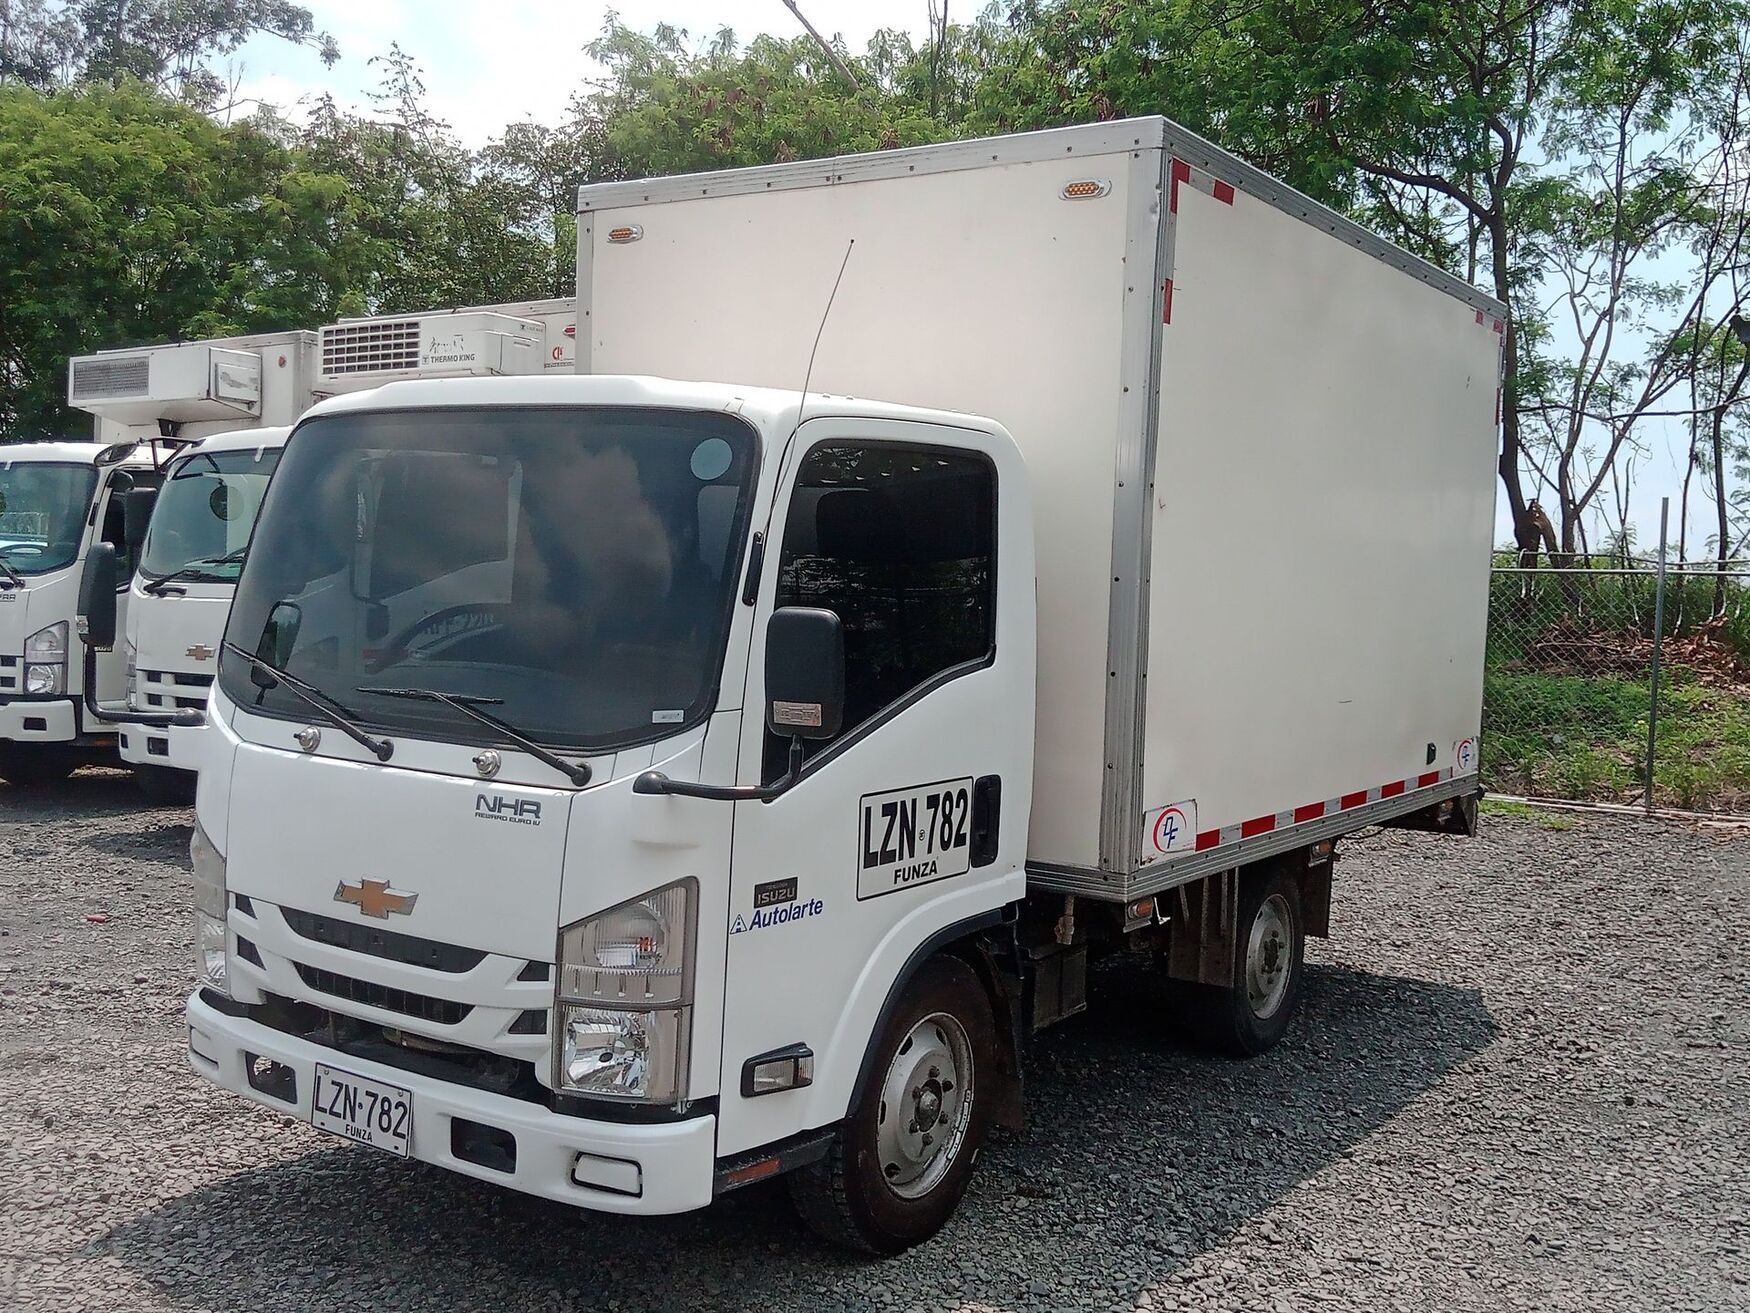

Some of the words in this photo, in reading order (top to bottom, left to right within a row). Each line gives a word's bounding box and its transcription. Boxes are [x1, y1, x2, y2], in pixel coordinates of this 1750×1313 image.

[431, 355, 459, 364] THERMO
[459, 353, 475, 361] KING
[475, 793, 541, 819] NHR
[475, 811, 508, 822] REWARD
[509, 816, 531, 825] EURO
[894, 860, 938, 885] FUNZA
[757, 887, 796, 905] ISUZU
[749, 898, 823, 931] Autolarte
[345, 1123, 373, 1142] FUNZA
